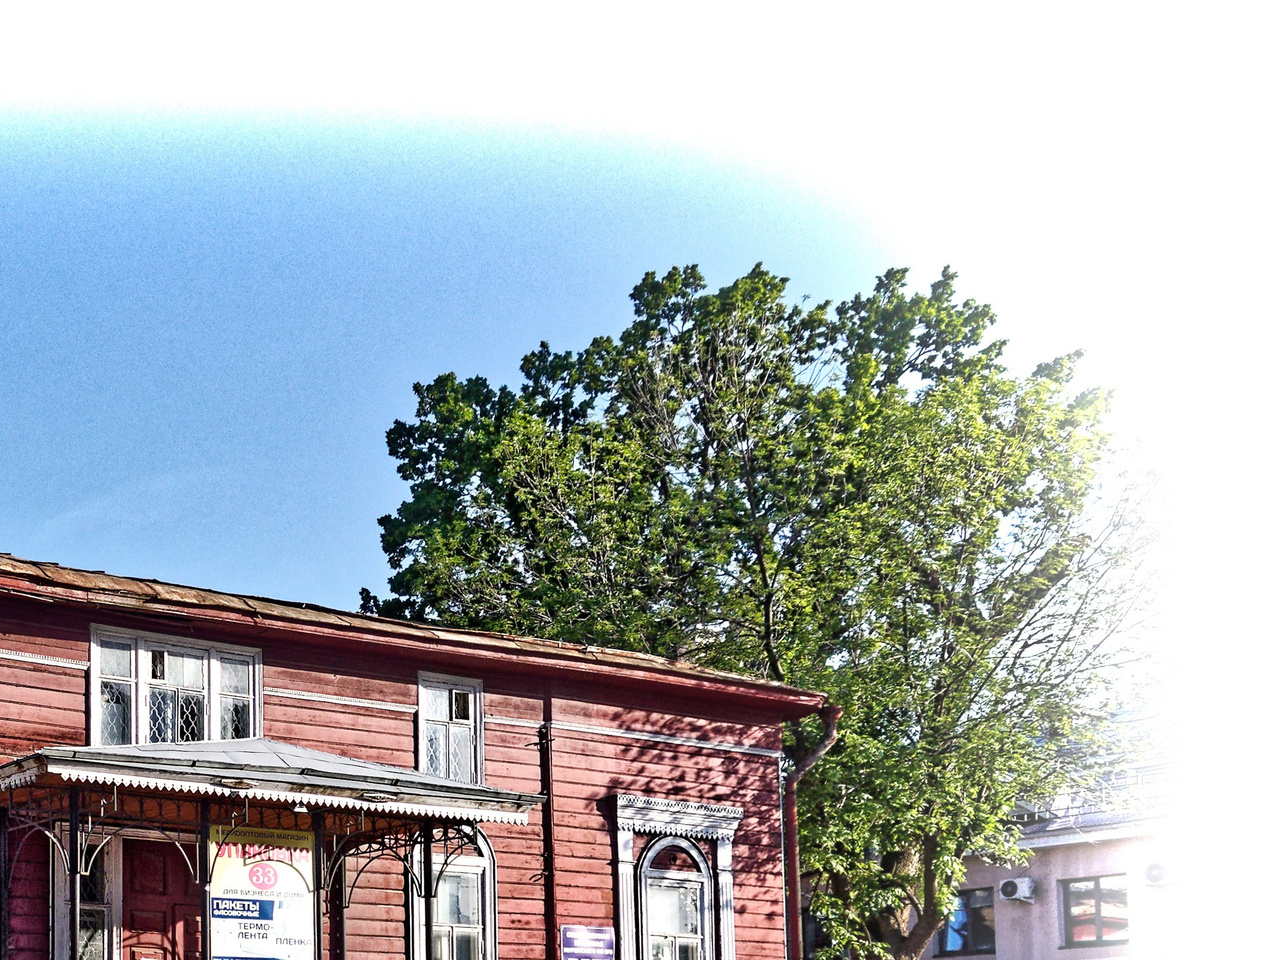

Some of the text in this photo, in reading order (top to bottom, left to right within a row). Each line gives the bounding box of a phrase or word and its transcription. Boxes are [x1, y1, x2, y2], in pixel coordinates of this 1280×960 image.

[276, 831, 309, 841] МАГАЗИН
[215, 841, 310, 863] УПАКОВКА
[252, 867, 275, 885] 33
[240, 889, 275, 897] БИЗНЕСА
[213, 900, 259, 910] ПАКЕТЫ
[238, 922, 274, 931] ТЕРМО-
[237, 931, 268, 940] ЛЕНТА
[275, 937, 312, 946] ПЛЕНКА
